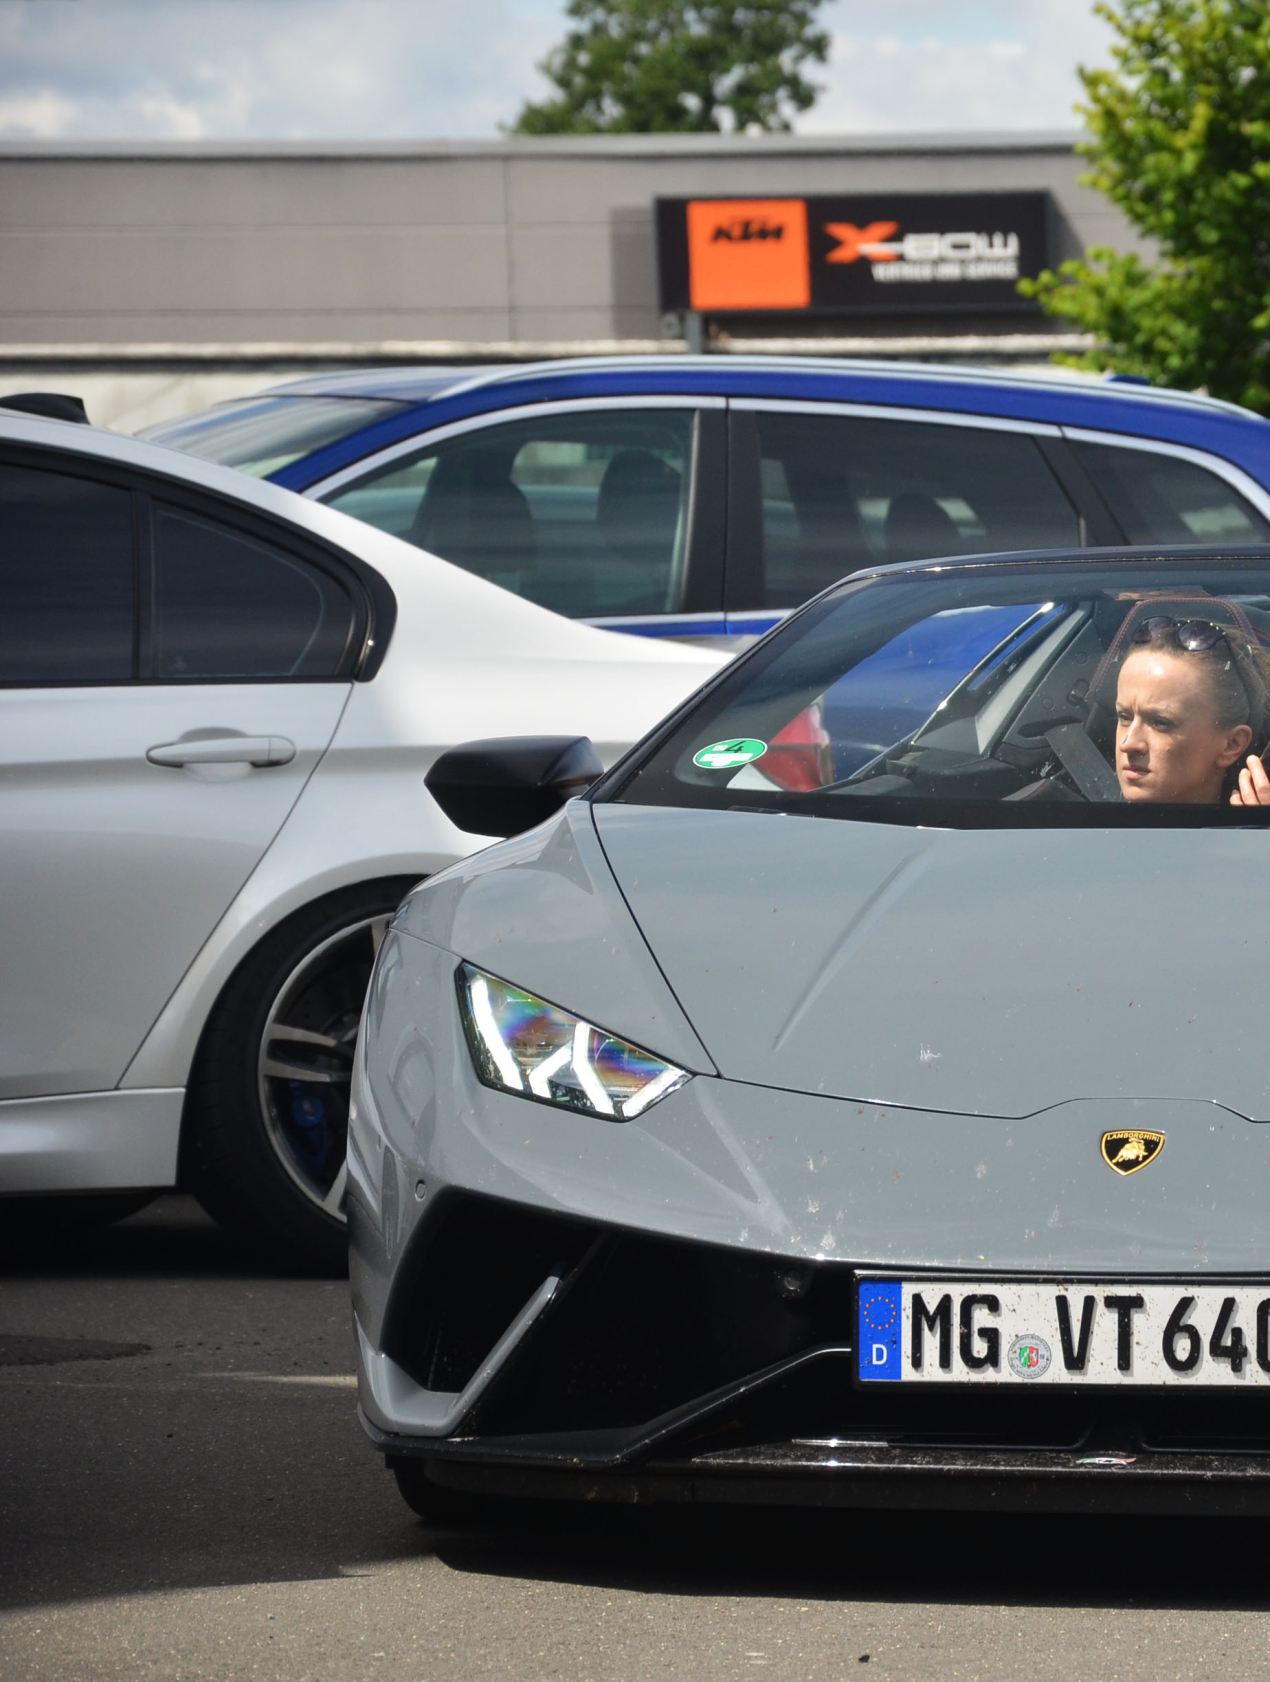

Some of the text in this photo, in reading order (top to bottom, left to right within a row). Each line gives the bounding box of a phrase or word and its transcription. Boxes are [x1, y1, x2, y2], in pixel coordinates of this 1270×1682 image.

[711, 217, 784, 243] KTM
[725, 740, 746, 753] 4
[1107, 1132, 1160, 1142] LAMBORGHINI
[910, 1292, 1001, 1372] MG
[872, 1343, 888, 1365] D
